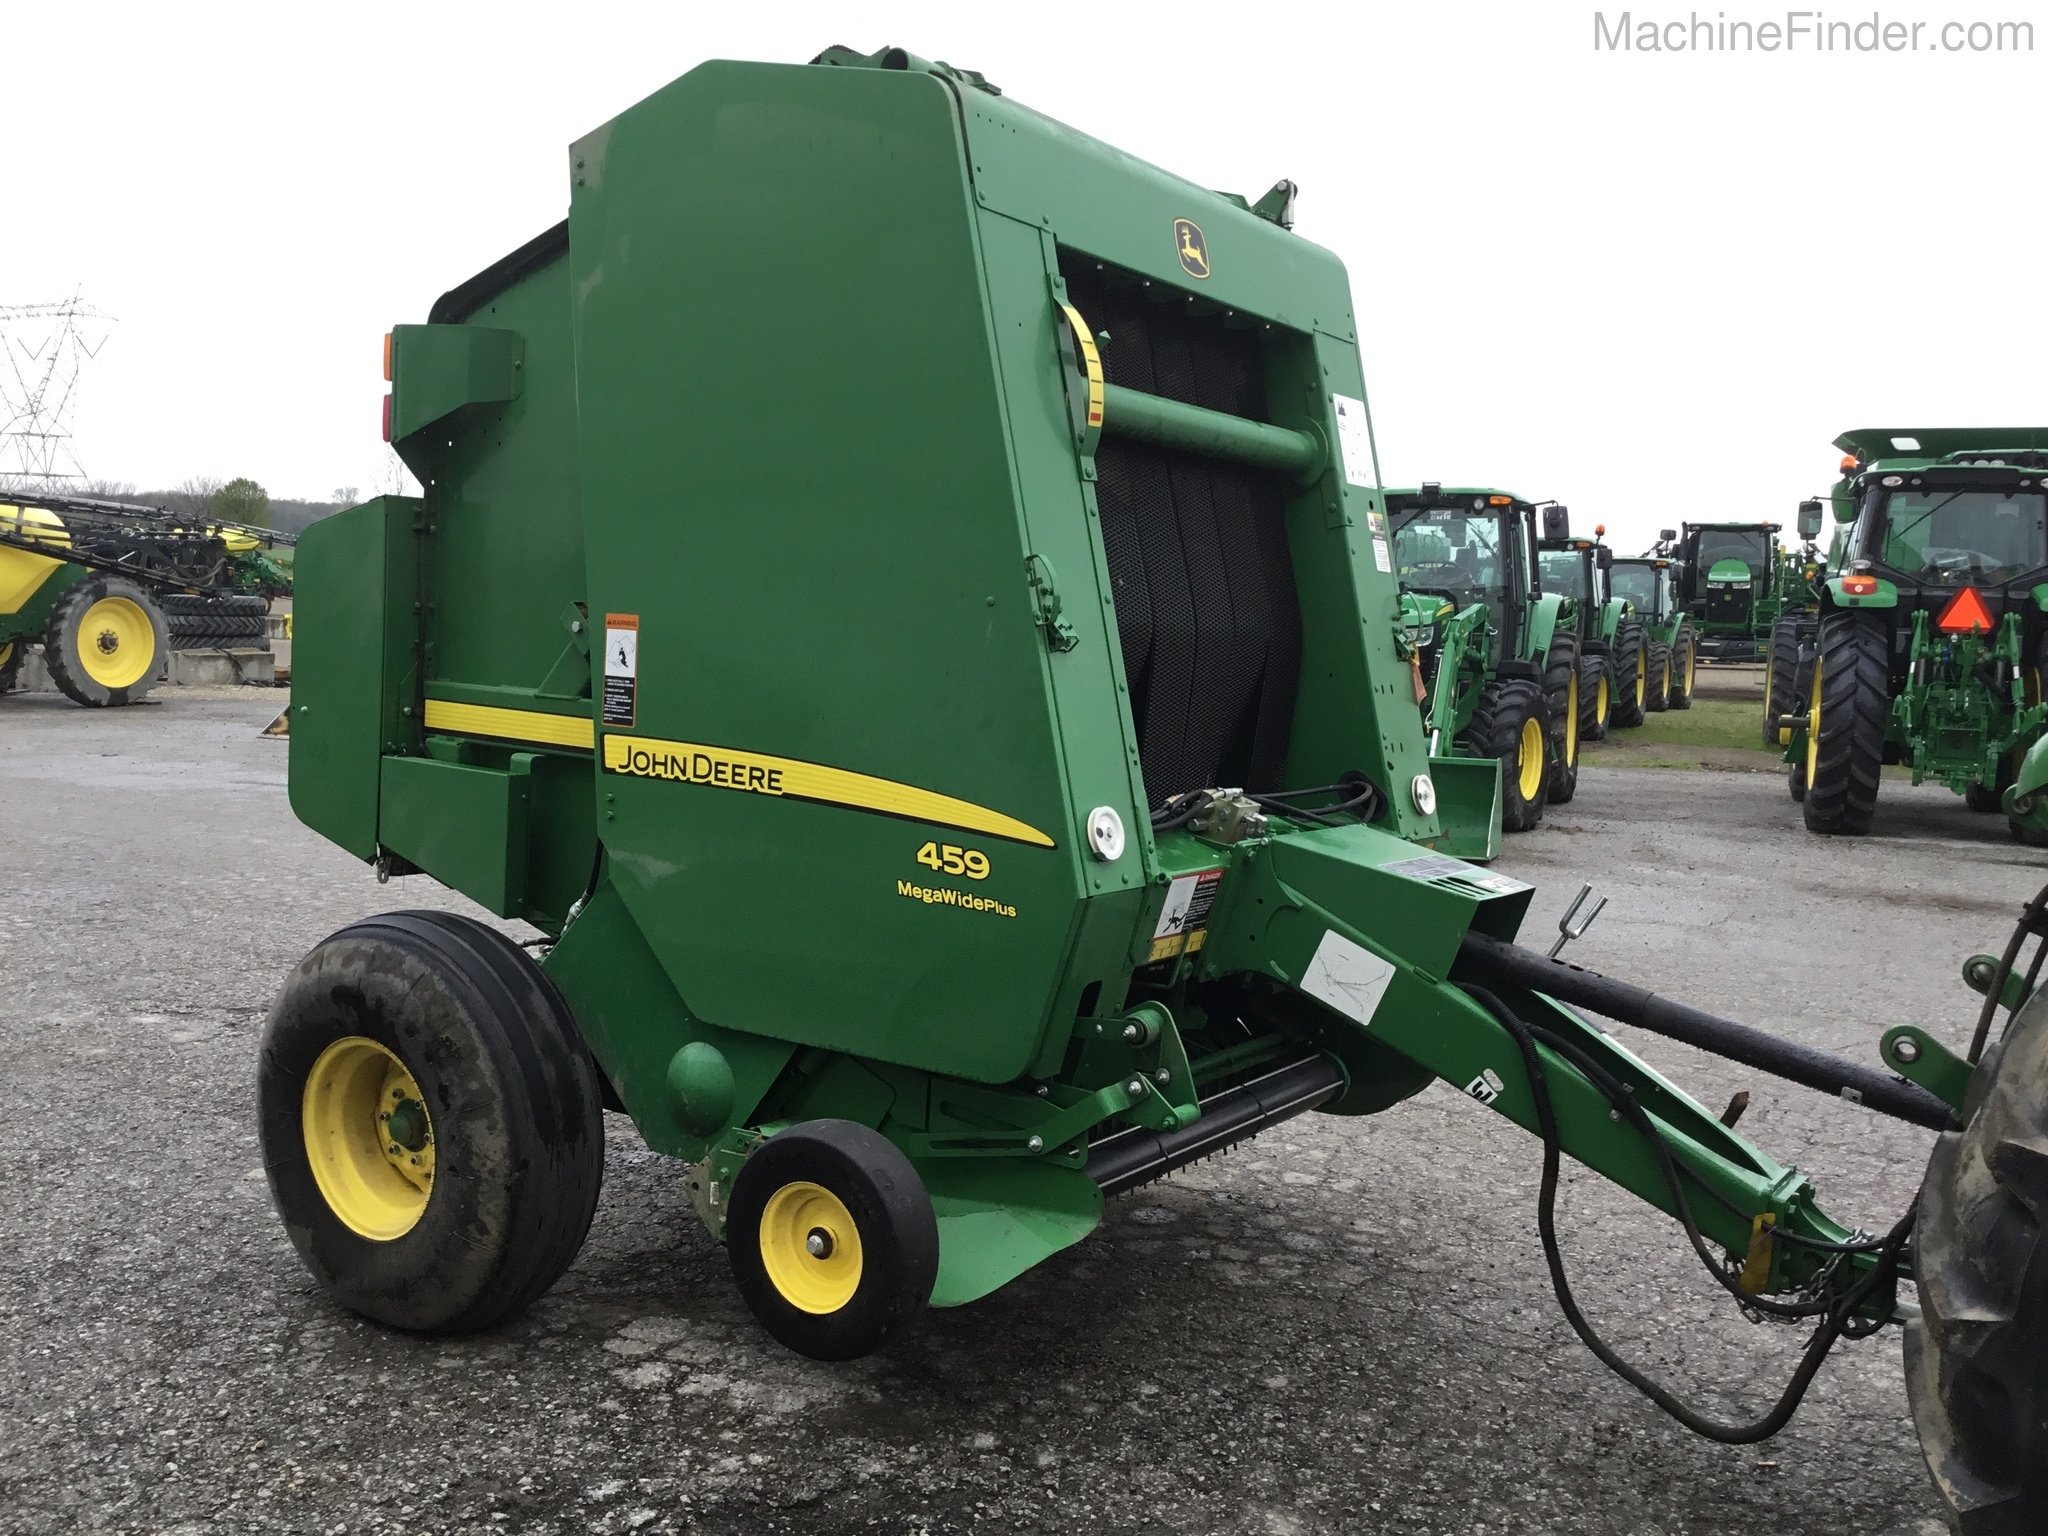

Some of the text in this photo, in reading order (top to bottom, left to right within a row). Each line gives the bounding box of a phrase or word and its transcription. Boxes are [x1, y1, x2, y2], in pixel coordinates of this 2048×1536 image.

[612, 619, 637, 627] WARNING
[618, 745, 783, 791] JOHN DEERE
[917, 841, 991, 880] 459
[897, 880, 1017, 917] MegaWidePlus
